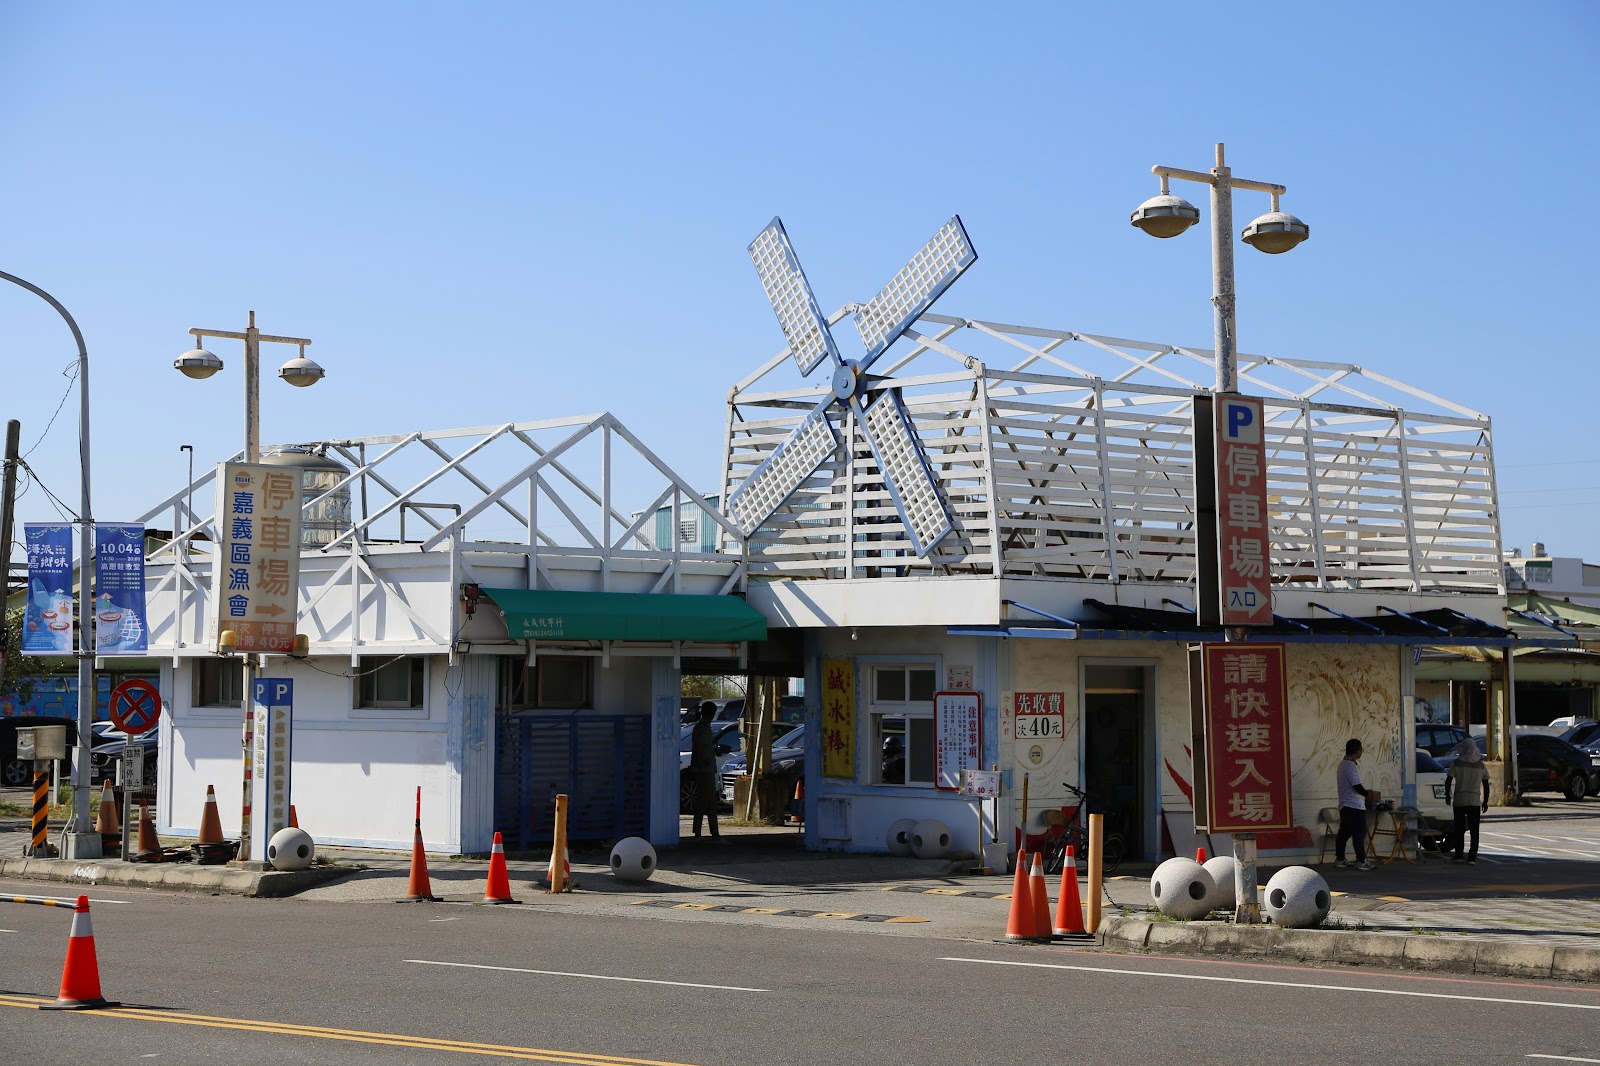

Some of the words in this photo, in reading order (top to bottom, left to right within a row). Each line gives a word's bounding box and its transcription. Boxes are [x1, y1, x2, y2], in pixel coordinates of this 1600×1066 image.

[1228, 404, 1253, 438] P
[1225, 444, 1264, 579] 停車場
[255, 472, 295, 597] 停車場
[101, 543, 134, 554] 10.04
[228, 491, 254, 617] 嘉義區漁會
[1230, 591, 1256, 607] 入口
[259, 636, 290, 649] 40元
[261, 623, 288, 635] 停車
[256, 683, 265, 700] P
[276, 683, 288, 700] P
[1017, 693, 1061, 714] 先收費
[828, 666, 846, 756] 鹹冰棒
[968, 706, 977, 759] 注意事項
[1222, 653, 1274, 822] 請快速入場
[126, 749, 134, 788] 臨時停車
[976, 786, 996, 795] 40元
